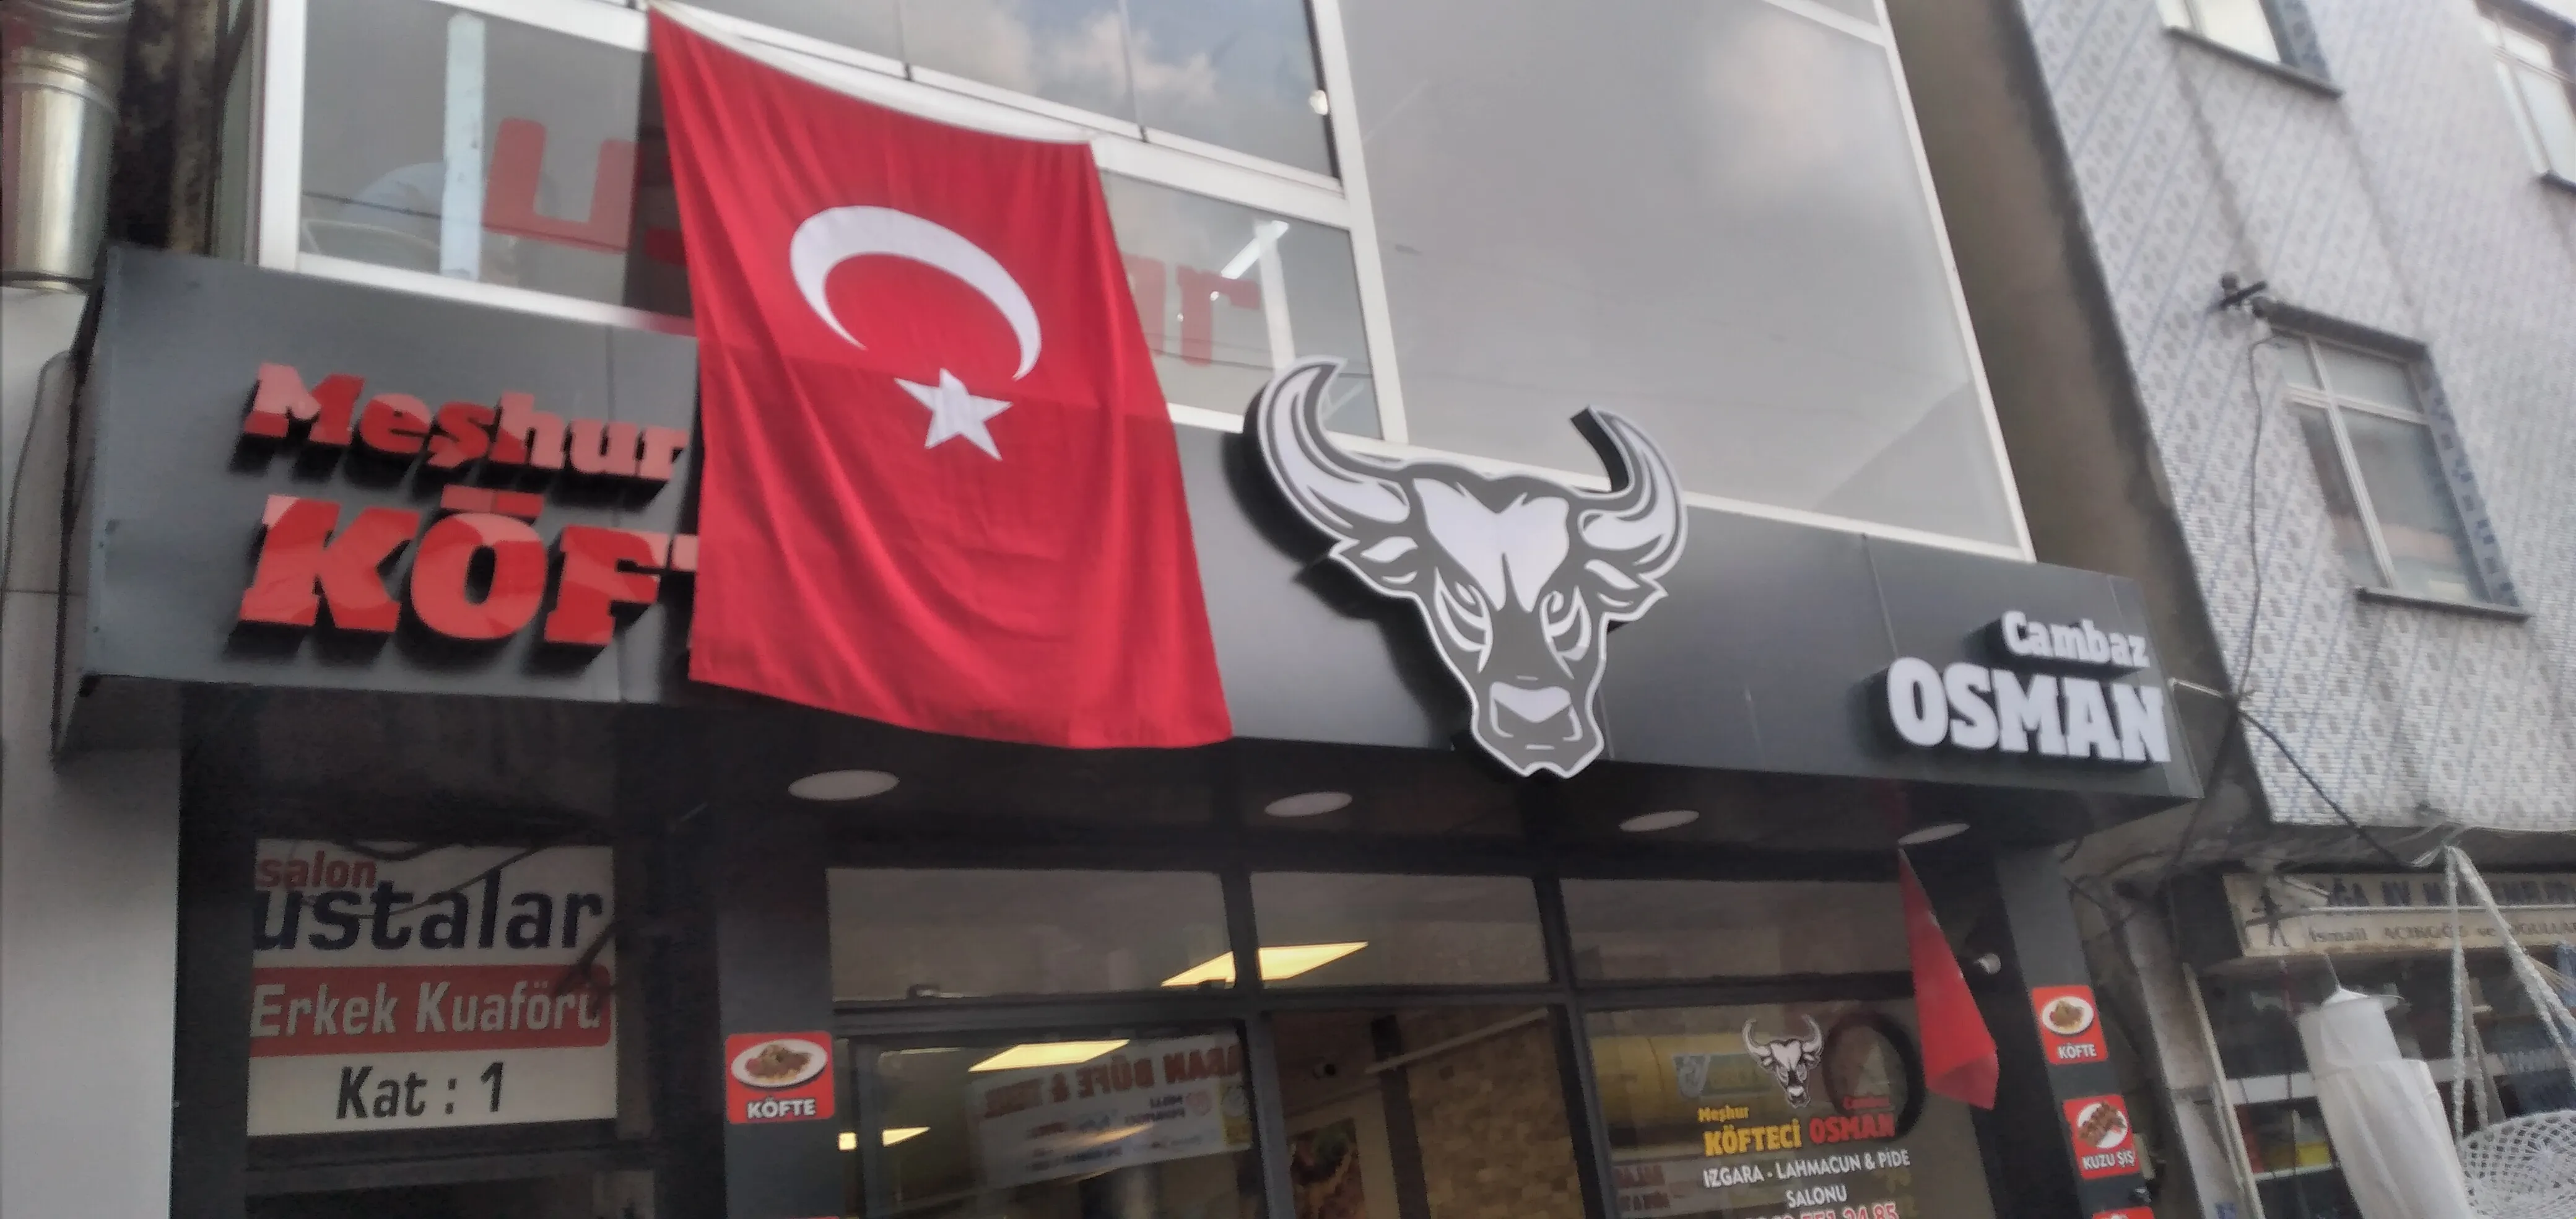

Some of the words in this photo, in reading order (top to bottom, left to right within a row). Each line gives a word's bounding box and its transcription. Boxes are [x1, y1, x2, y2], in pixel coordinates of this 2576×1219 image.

[243, 362, 691, 480] Meşhur
[239, 484, 699, 645] KÖF
[2001, 610, 2150, 668] Cambaz
[1886, 656, 2172, 762] OSMAN
[255, 850, 377, 889] salon
[253, 868, 603, 951] ustalar
[250, 981, 398, 1038] Erkek
[2056, 1042, 2097, 1060] KÖFTE
[336, 1065, 427, 1119] Kat
[480, 1061, 505, 1113] 1
[746, 1096, 816, 1119] KÖFTE
[1698, 1104, 1749, 1123] Meşhur
[1704, 1117, 1803, 1157] KÖFTECİ
[1809, 1112, 1895, 1145] OSMAN
[1703, 1164, 1765, 1189] IZGARA
[1774, 1153, 1861, 1181] LAHMACUN
[1862, 1151, 1876, 1170] &
[1878, 1147, 1911, 1169] PİDE
[2082, 1153, 2115, 1170] KUZU
[1785, 1183, 1848, 1208] SALONU
